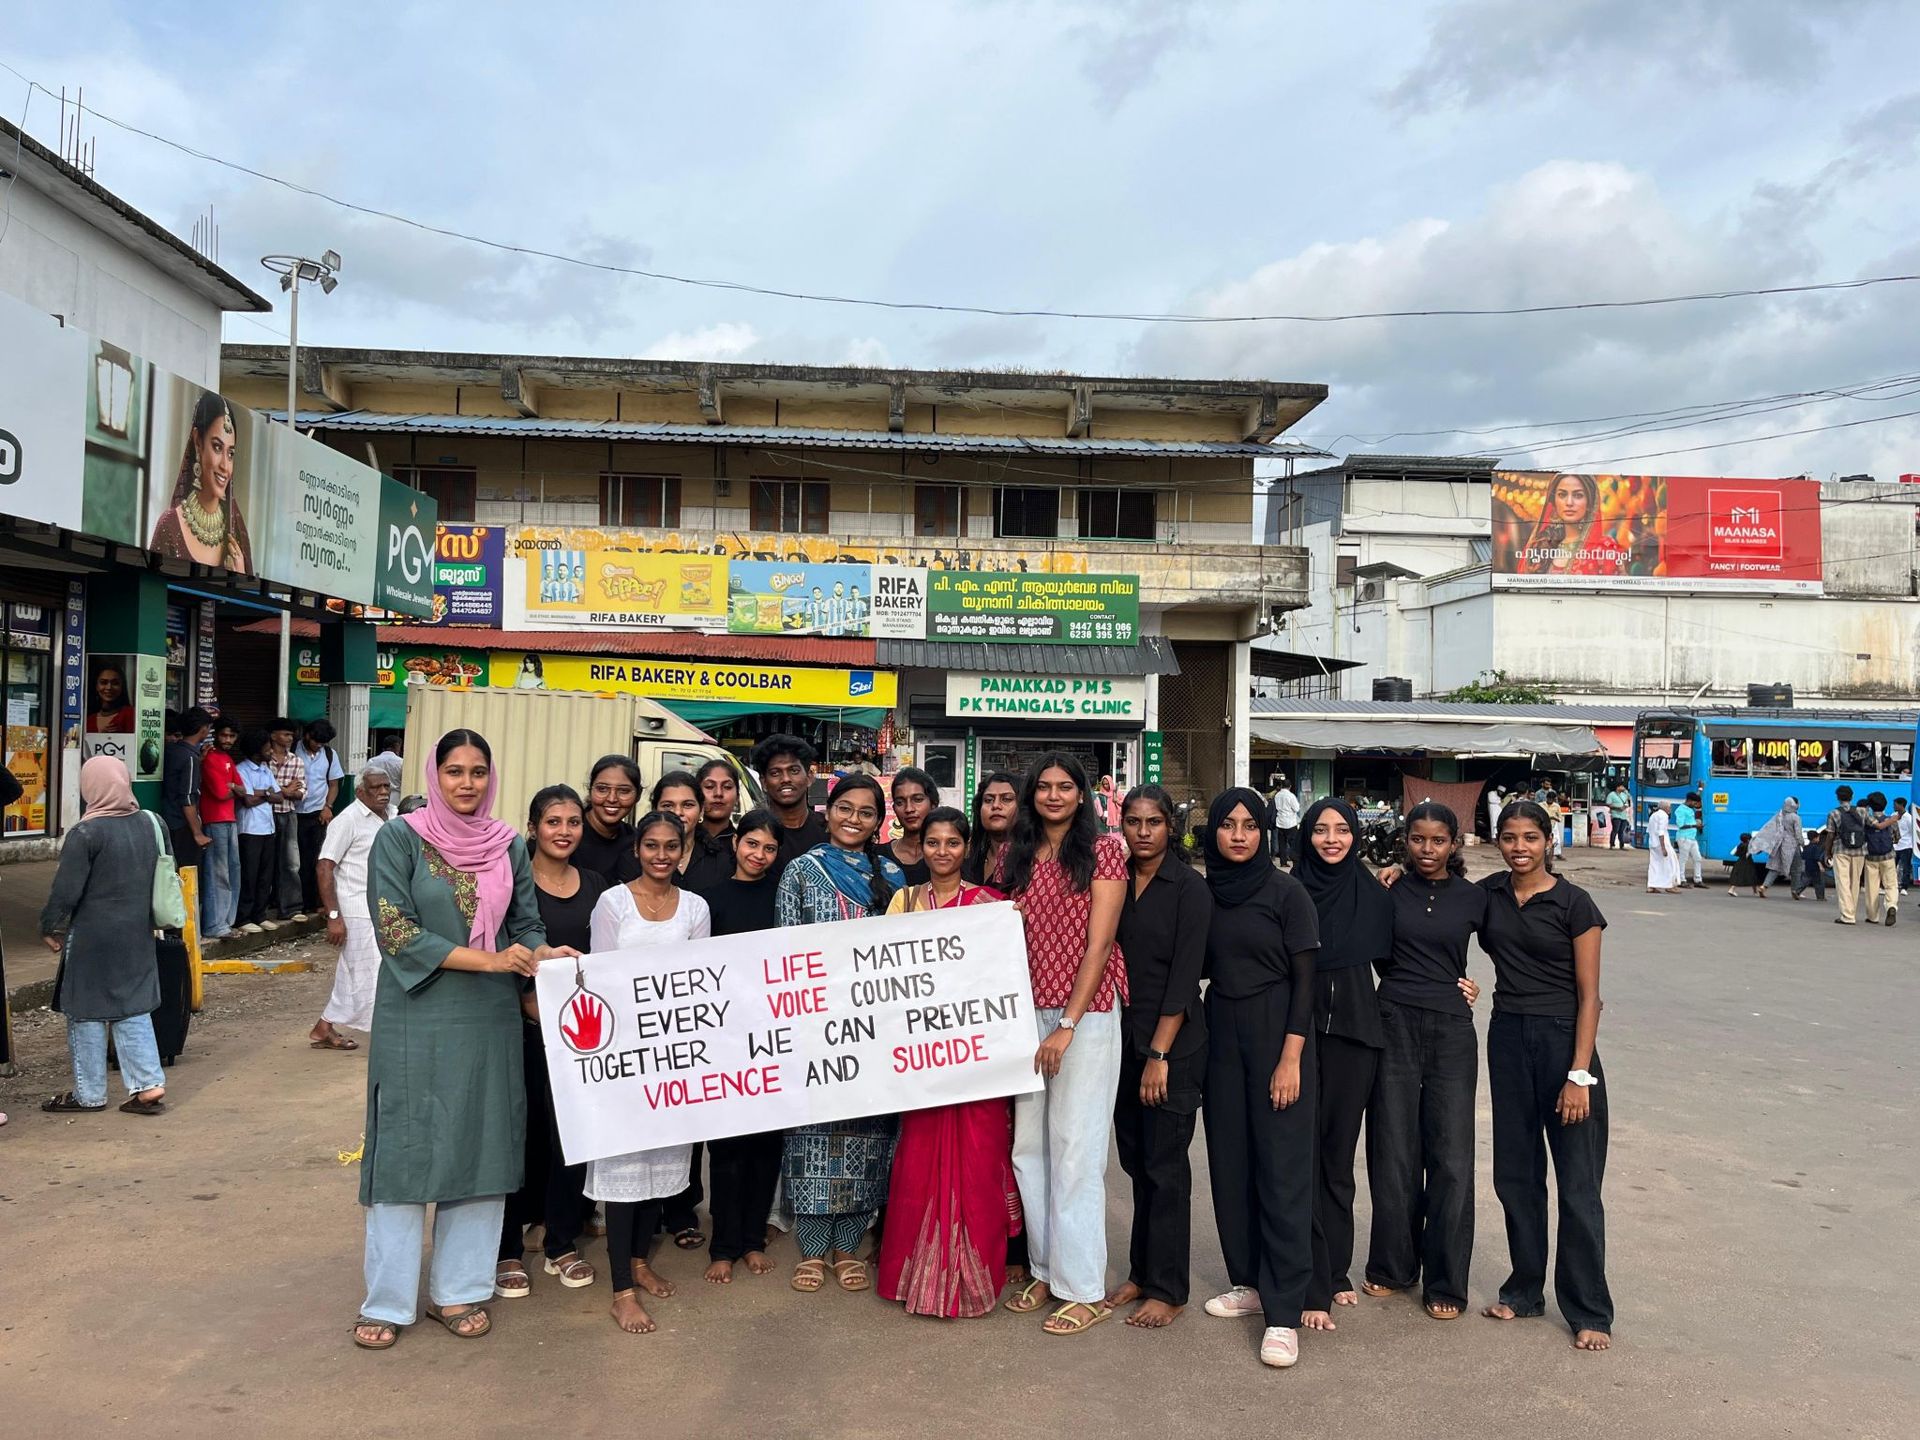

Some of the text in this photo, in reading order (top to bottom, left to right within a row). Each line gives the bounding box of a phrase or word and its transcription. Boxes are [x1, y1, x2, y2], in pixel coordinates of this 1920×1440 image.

[1714, 526, 1777, 538] MAANASA
[387, 523, 436, 585] PGM
[1710, 562, 1781, 572] FANCY FOOTWEAR
[878, 576, 920, 595] RIFA
[934, 575, 952, 591] പി.
[954, 579, 980, 594] എം.
[983, 577, 1018, 595] എസ്.
[1021, 580, 1097, 596] ആയുർവേദ
[874, 595, 923, 609] BAKERY
[1016, 595, 1105, 611] ചികിത്സാലയം
[589, 612, 616, 623] RIFA
[619, 613, 666, 624] BAKERY
[1069, 622, 1092, 631] 9447
[1069, 630, 1132, 640] 6238 395 217
[590, 664, 792, 690] RIFA BAKERY & COOLBAR
[980, 677, 1113, 695] PANAKKAD P M S
[959, 697, 1132, 715] P K THANGAL'S CLINIC
[94, 741, 126, 757] PGM
[1646, 757, 1678, 771] GALAXY
[633, 935, 966, 1004] EVERY LIFE MATTERS
[637, 972, 937, 1040] EVERY VOICE COUNTS
[574, 992, 1020, 1085] TOGETHER WE CAN PREVENT
[643, 1034, 990, 1111] VIOLENCE AND SUICIDE
